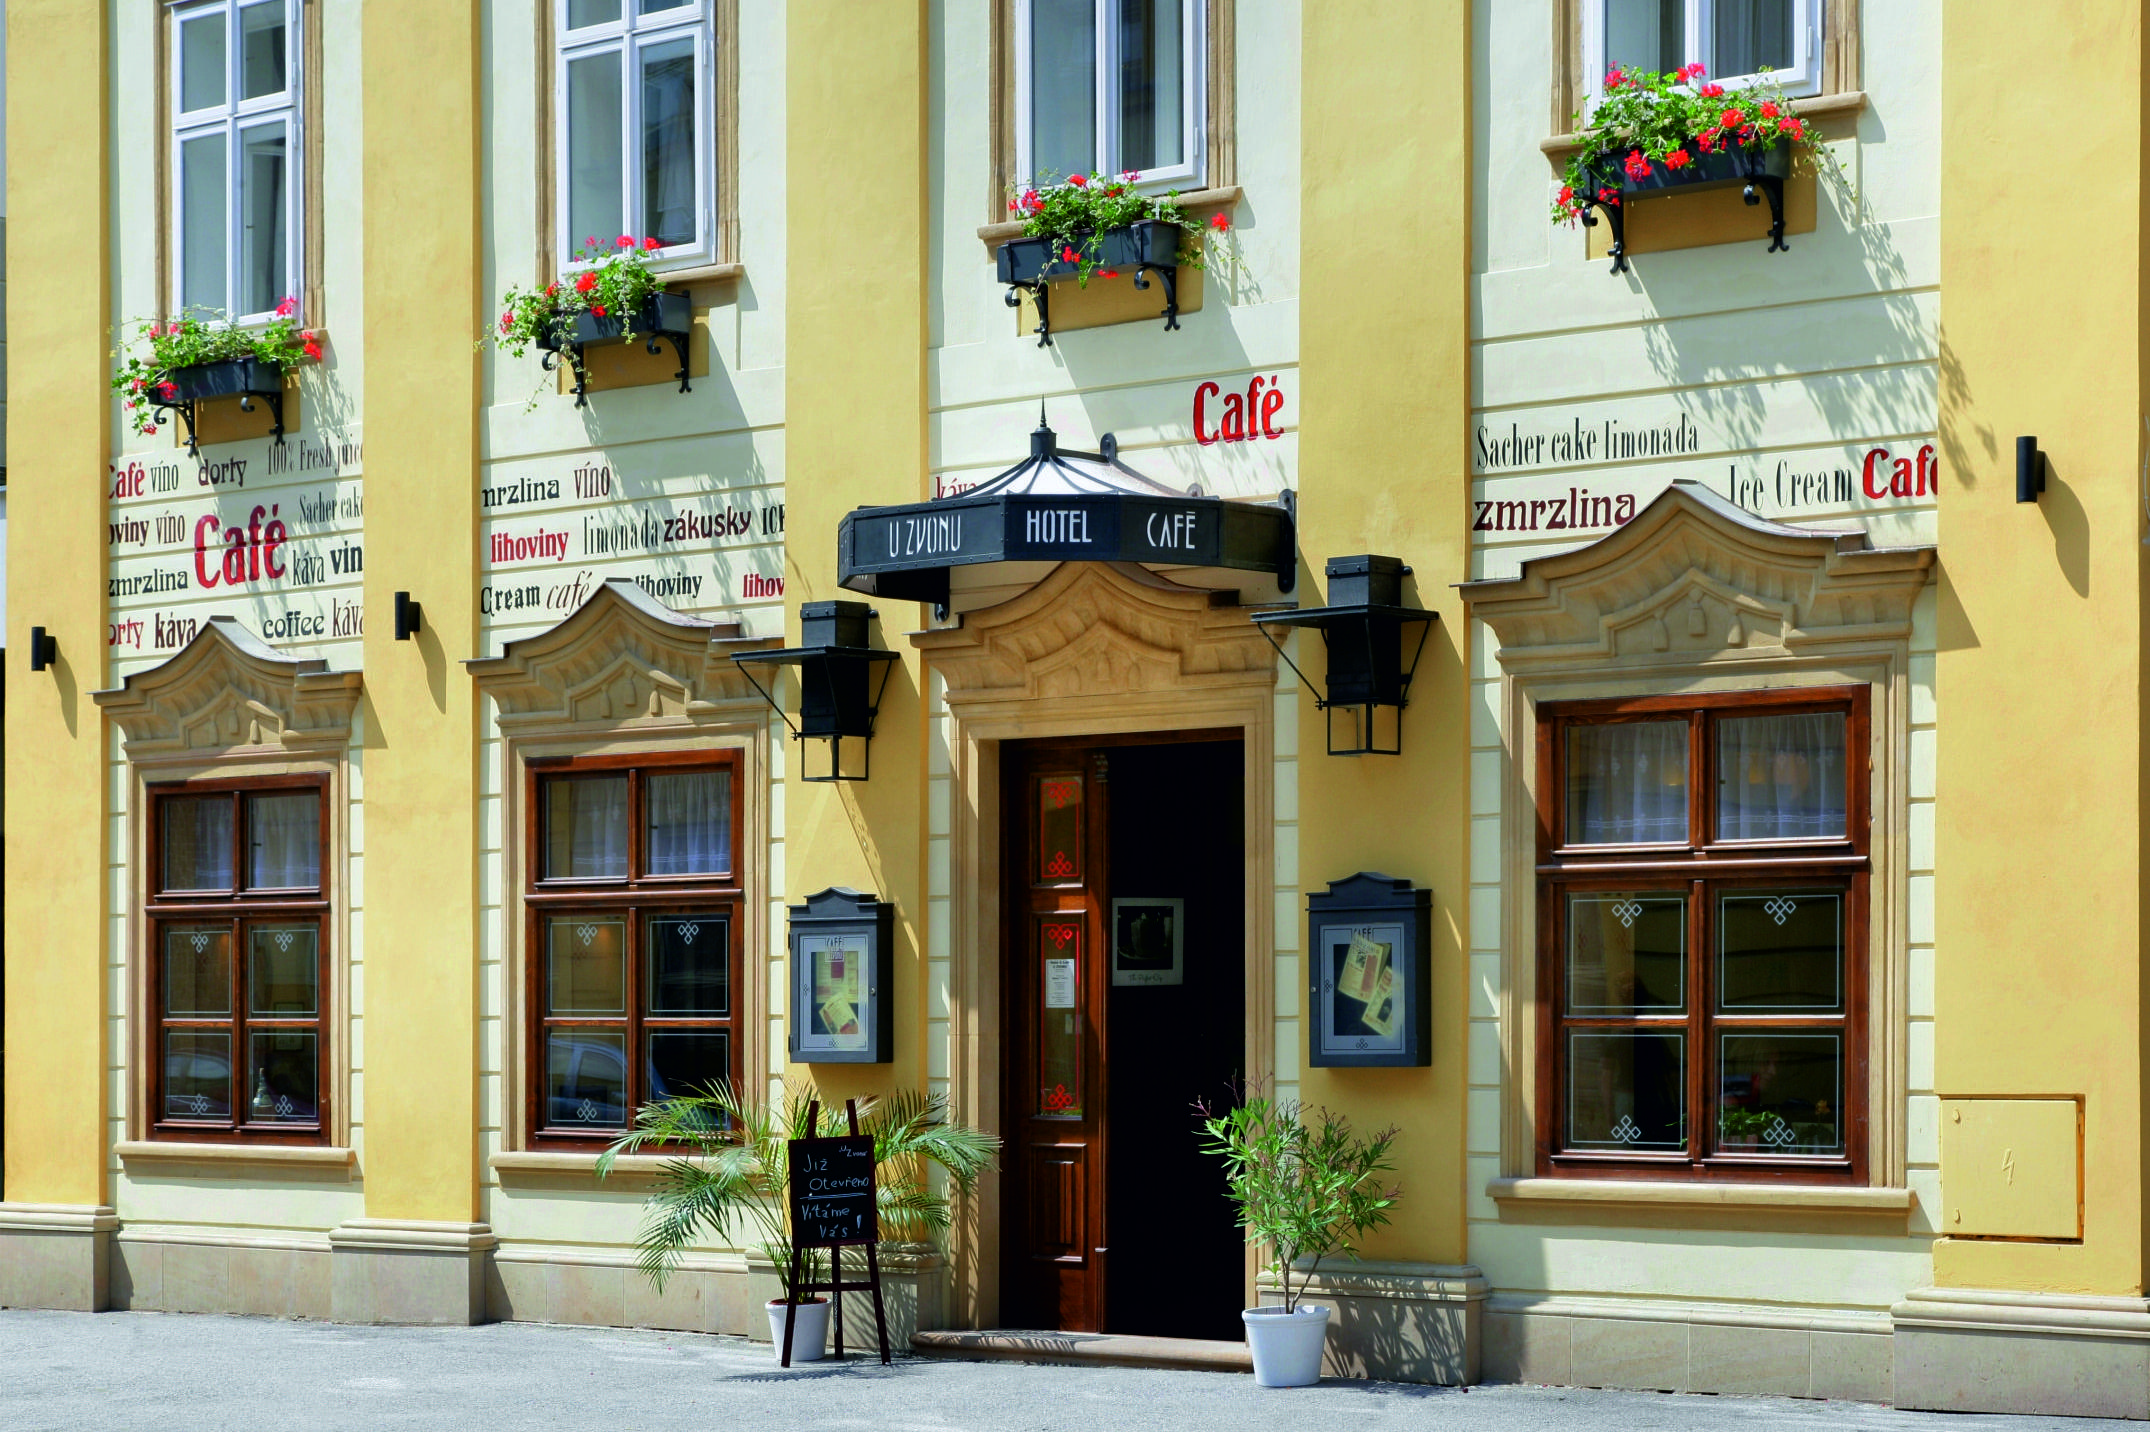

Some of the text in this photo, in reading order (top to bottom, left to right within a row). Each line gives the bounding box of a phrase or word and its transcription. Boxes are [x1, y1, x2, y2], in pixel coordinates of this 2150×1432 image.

[1193, 375, 1284, 446] Café
[1477, 423, 1544, 469] Sacher
[1551, 417, 1597, 462] cake
[150, 459, 179, 493] víno
[197, 457, 247, 487] dorty
[300, 436, 332, 471] Fresh
[574, 461, 610, 499] víno
[1730, 464, 1764, 511] Ice
[1775, 458, 1853, 508] Cream
[156, 510, 185, 544] víno
[300, 490, 337, 525] Sacher
[1026, 509, 1093, 544] HOTEL
[1472, 487, 1636, 531] zmrzlina
[194, 503, 287, 589] Café
[491, 528, 569, 563] lihoviny
[664, 506, 752, 543] zákusky
[889, 520, 899, 558] U
[905, 514, 961, 556] ZVONU
[109, 568, 189, 597] zmrzlina
[292, 549, 325, 586] káva
[480, 584, 541, 617] Cream
[547, 570, 593, 617] café
[154, 611, 197, 648] káva
[263, 610, 325, 639] coffee
[809, 1176, 869, 1191] Otevřeno
[801, 1203, 850, 1221] Vítáme
